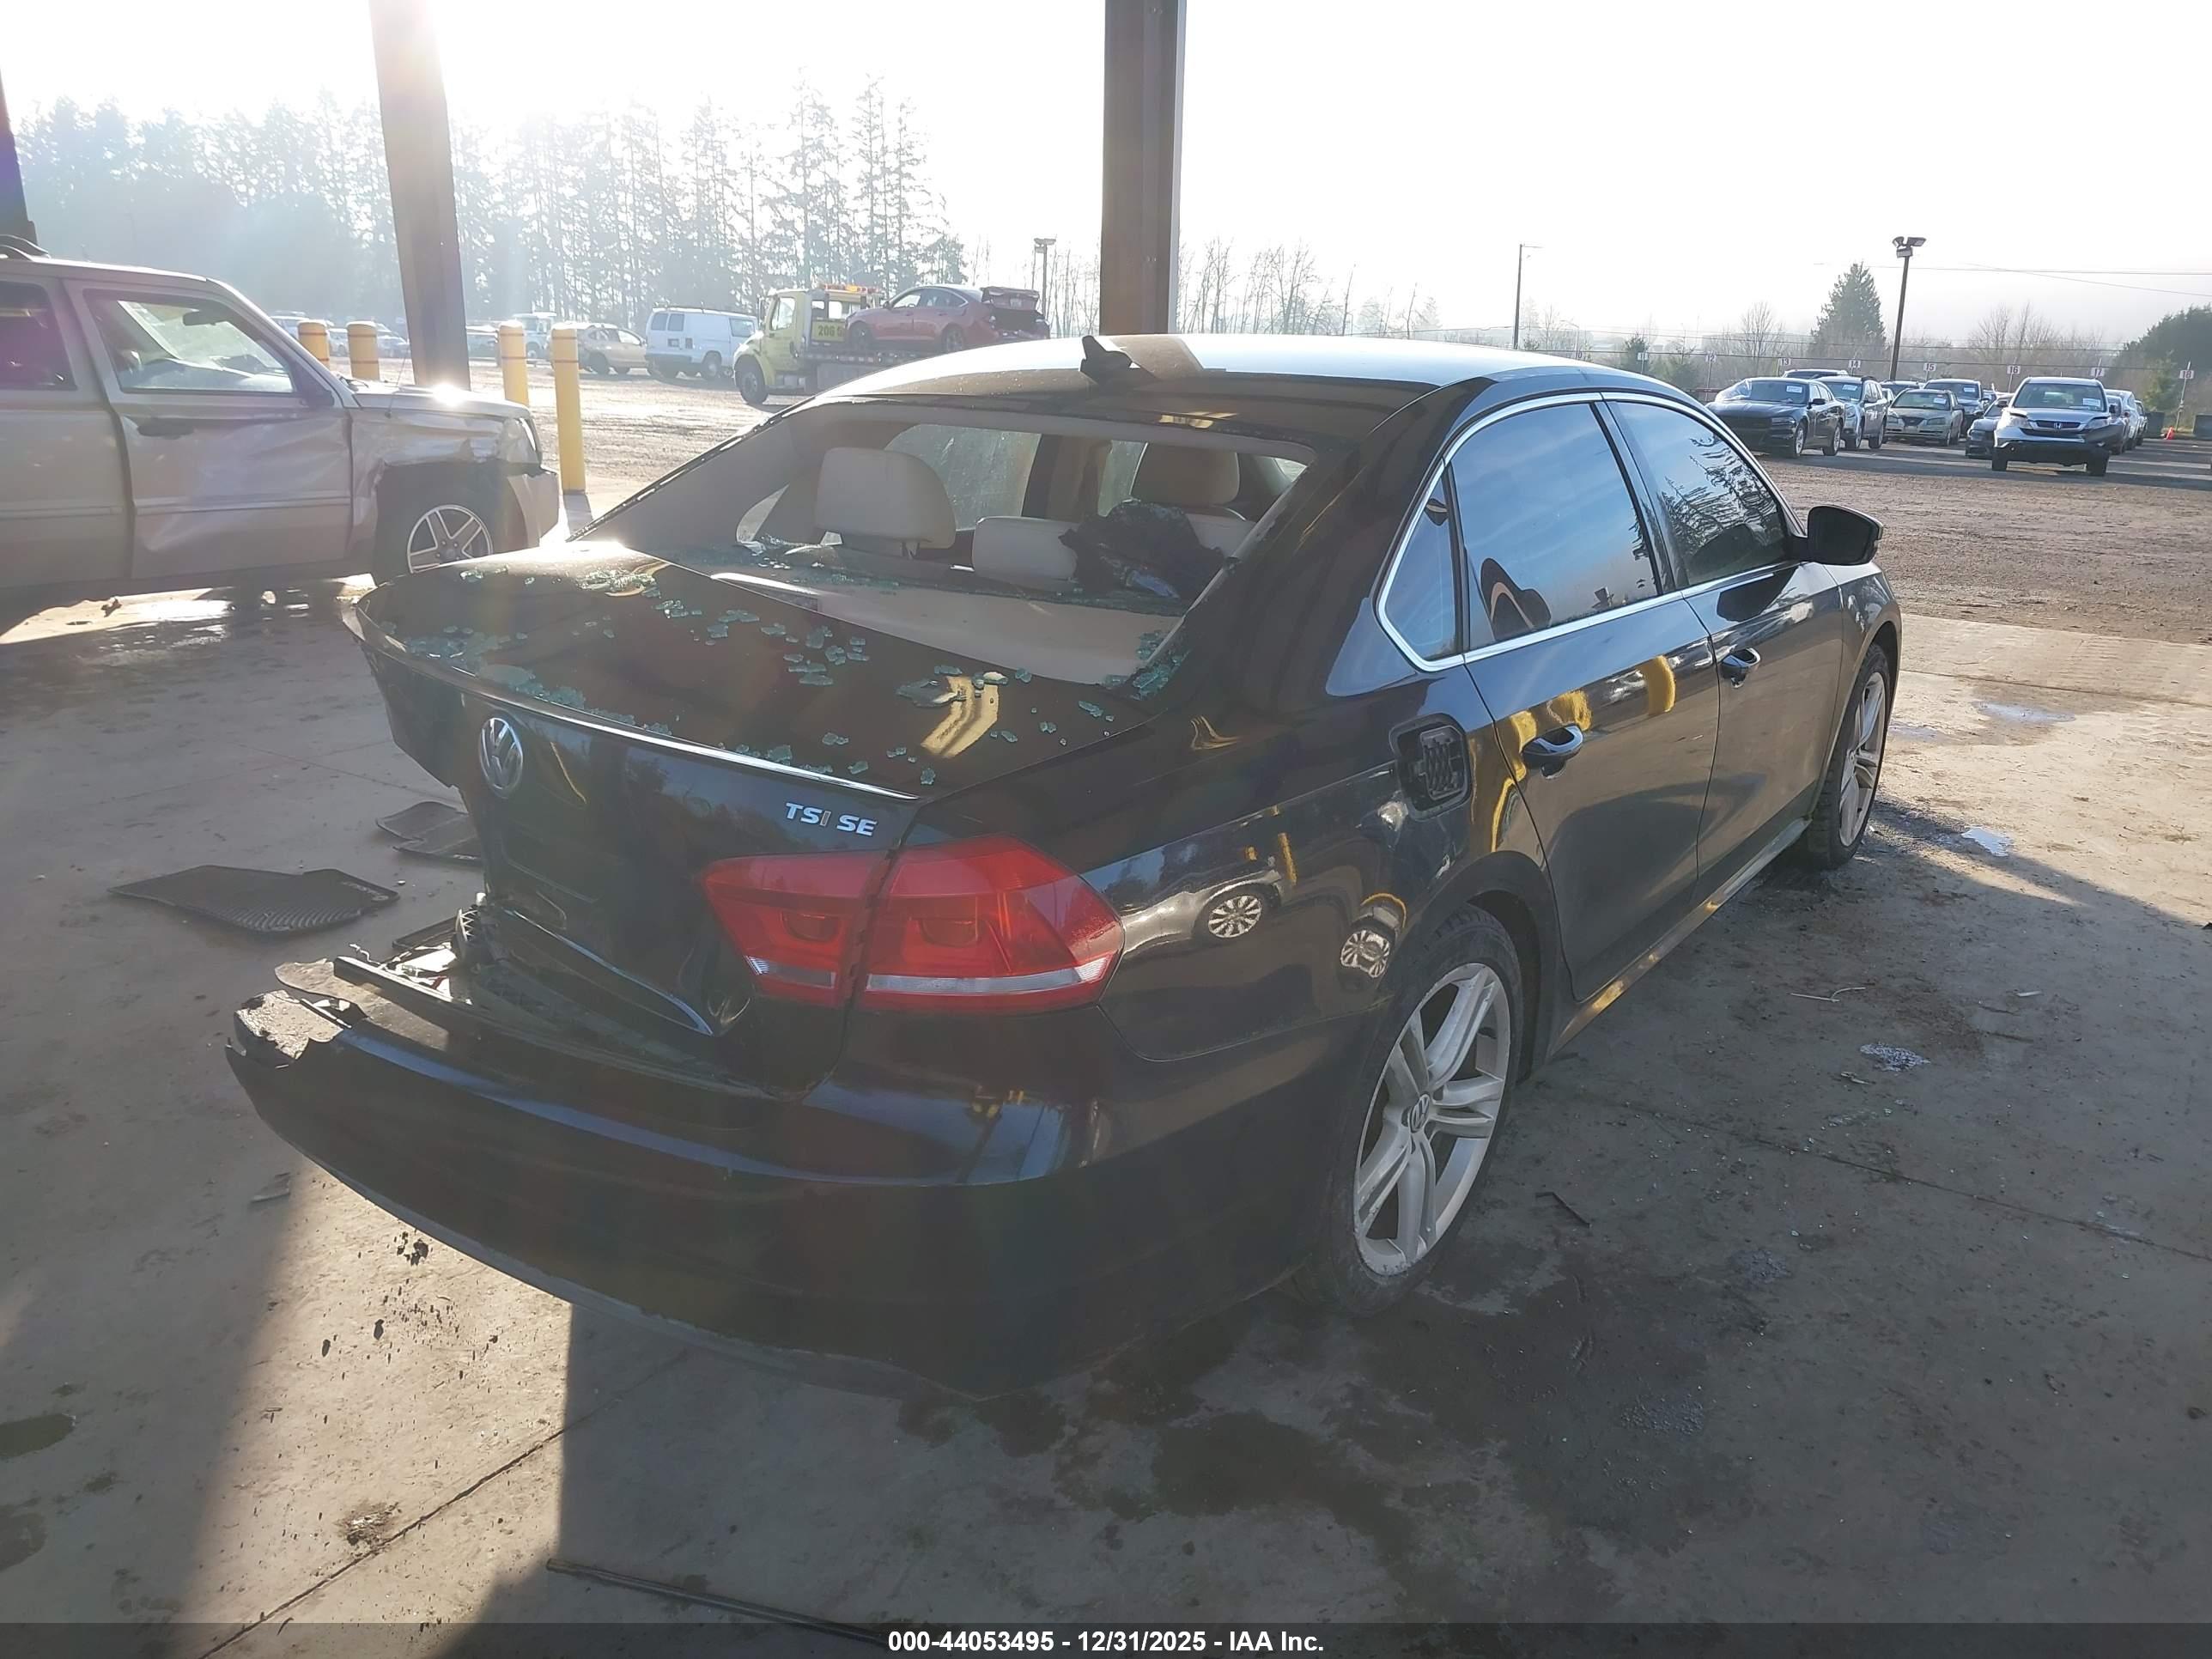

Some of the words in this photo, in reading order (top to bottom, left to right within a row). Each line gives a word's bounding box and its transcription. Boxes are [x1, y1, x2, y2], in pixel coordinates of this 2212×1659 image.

[2184, 370, 2192, 379] 18
[786, 802, 832, 826] TSI
[836, 814, 878, 836] SE
